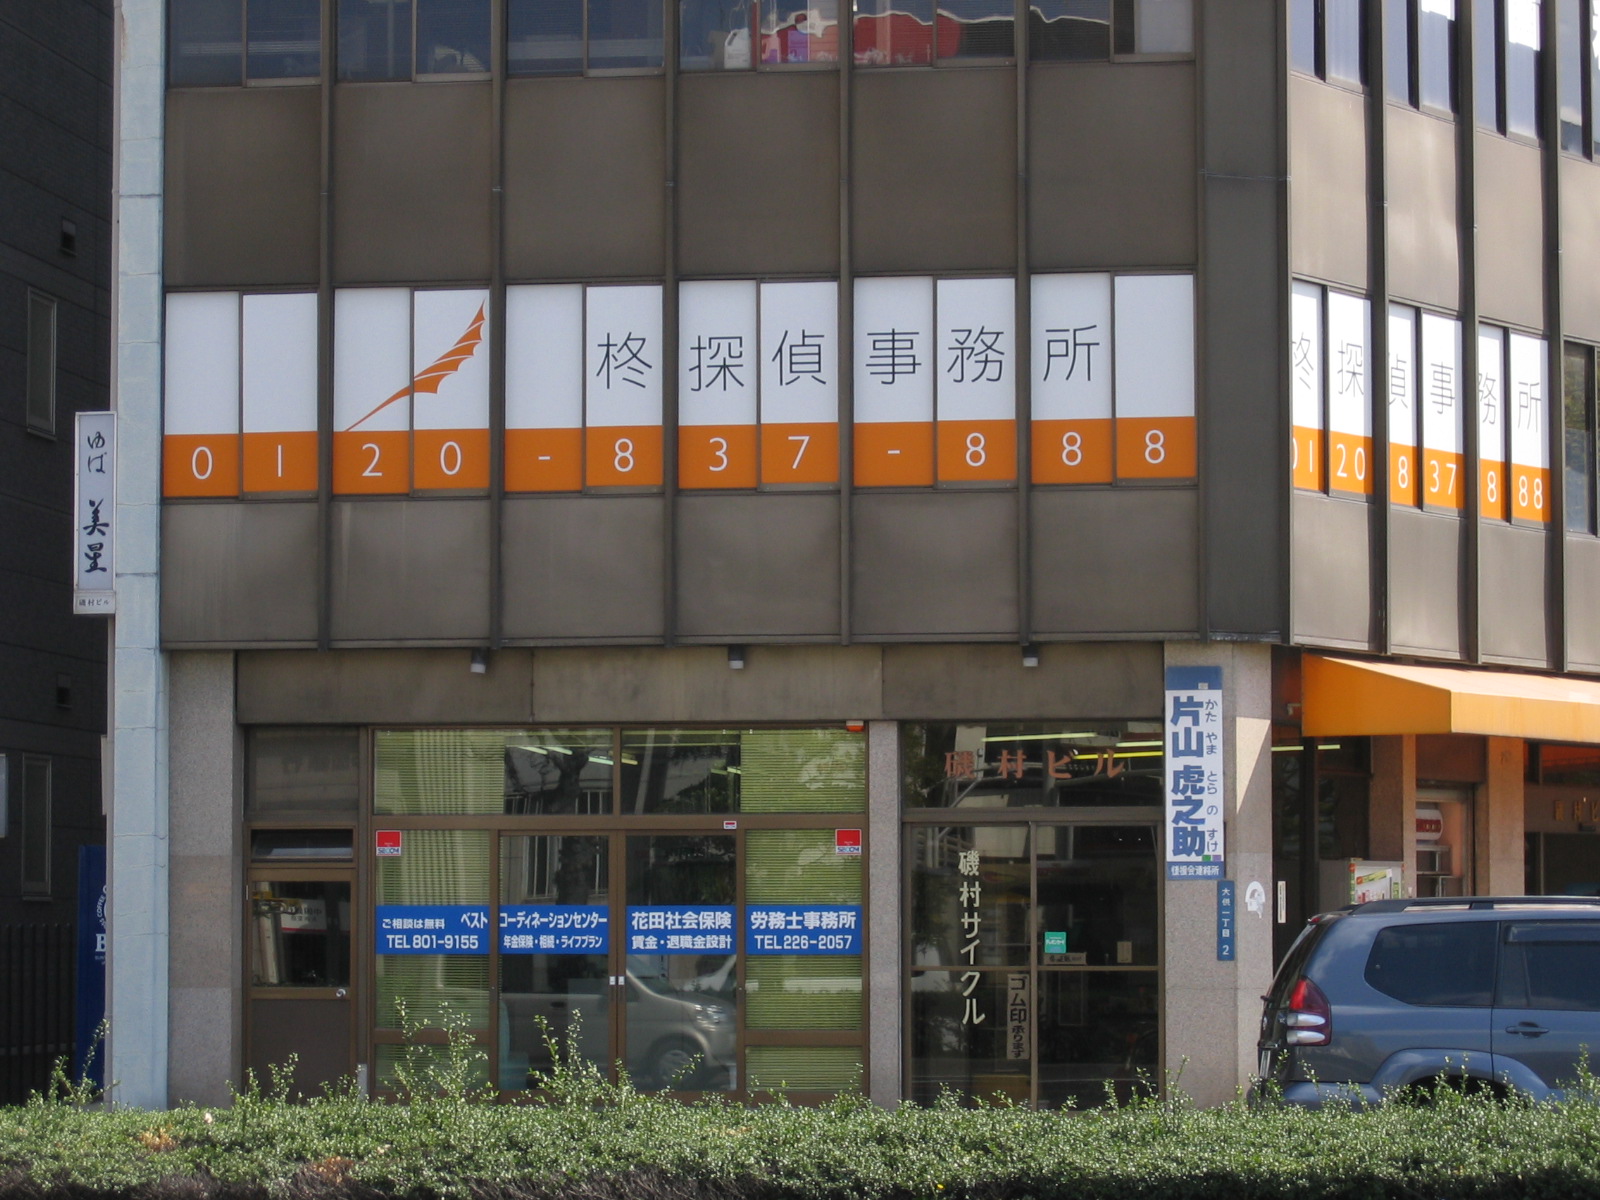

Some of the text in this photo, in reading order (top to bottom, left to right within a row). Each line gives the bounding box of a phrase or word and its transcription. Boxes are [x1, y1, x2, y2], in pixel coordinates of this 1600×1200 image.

[597, 324, 1100, 391] 柊探偵事務所
[83, 431, 110, 573] ゆば 美星
[944, 749, 1126, 780] 磯村ビル
[1170, 695, 1207, 857] 片山虎之助
[382, 917, 445, 930] ご相談は無料
[631, 911, 857, 930] 花田社会保険 労務士事務所
[958, 850, 986, 1026] 磯村サイクル
[1222, 944, 1230, 956] 2
